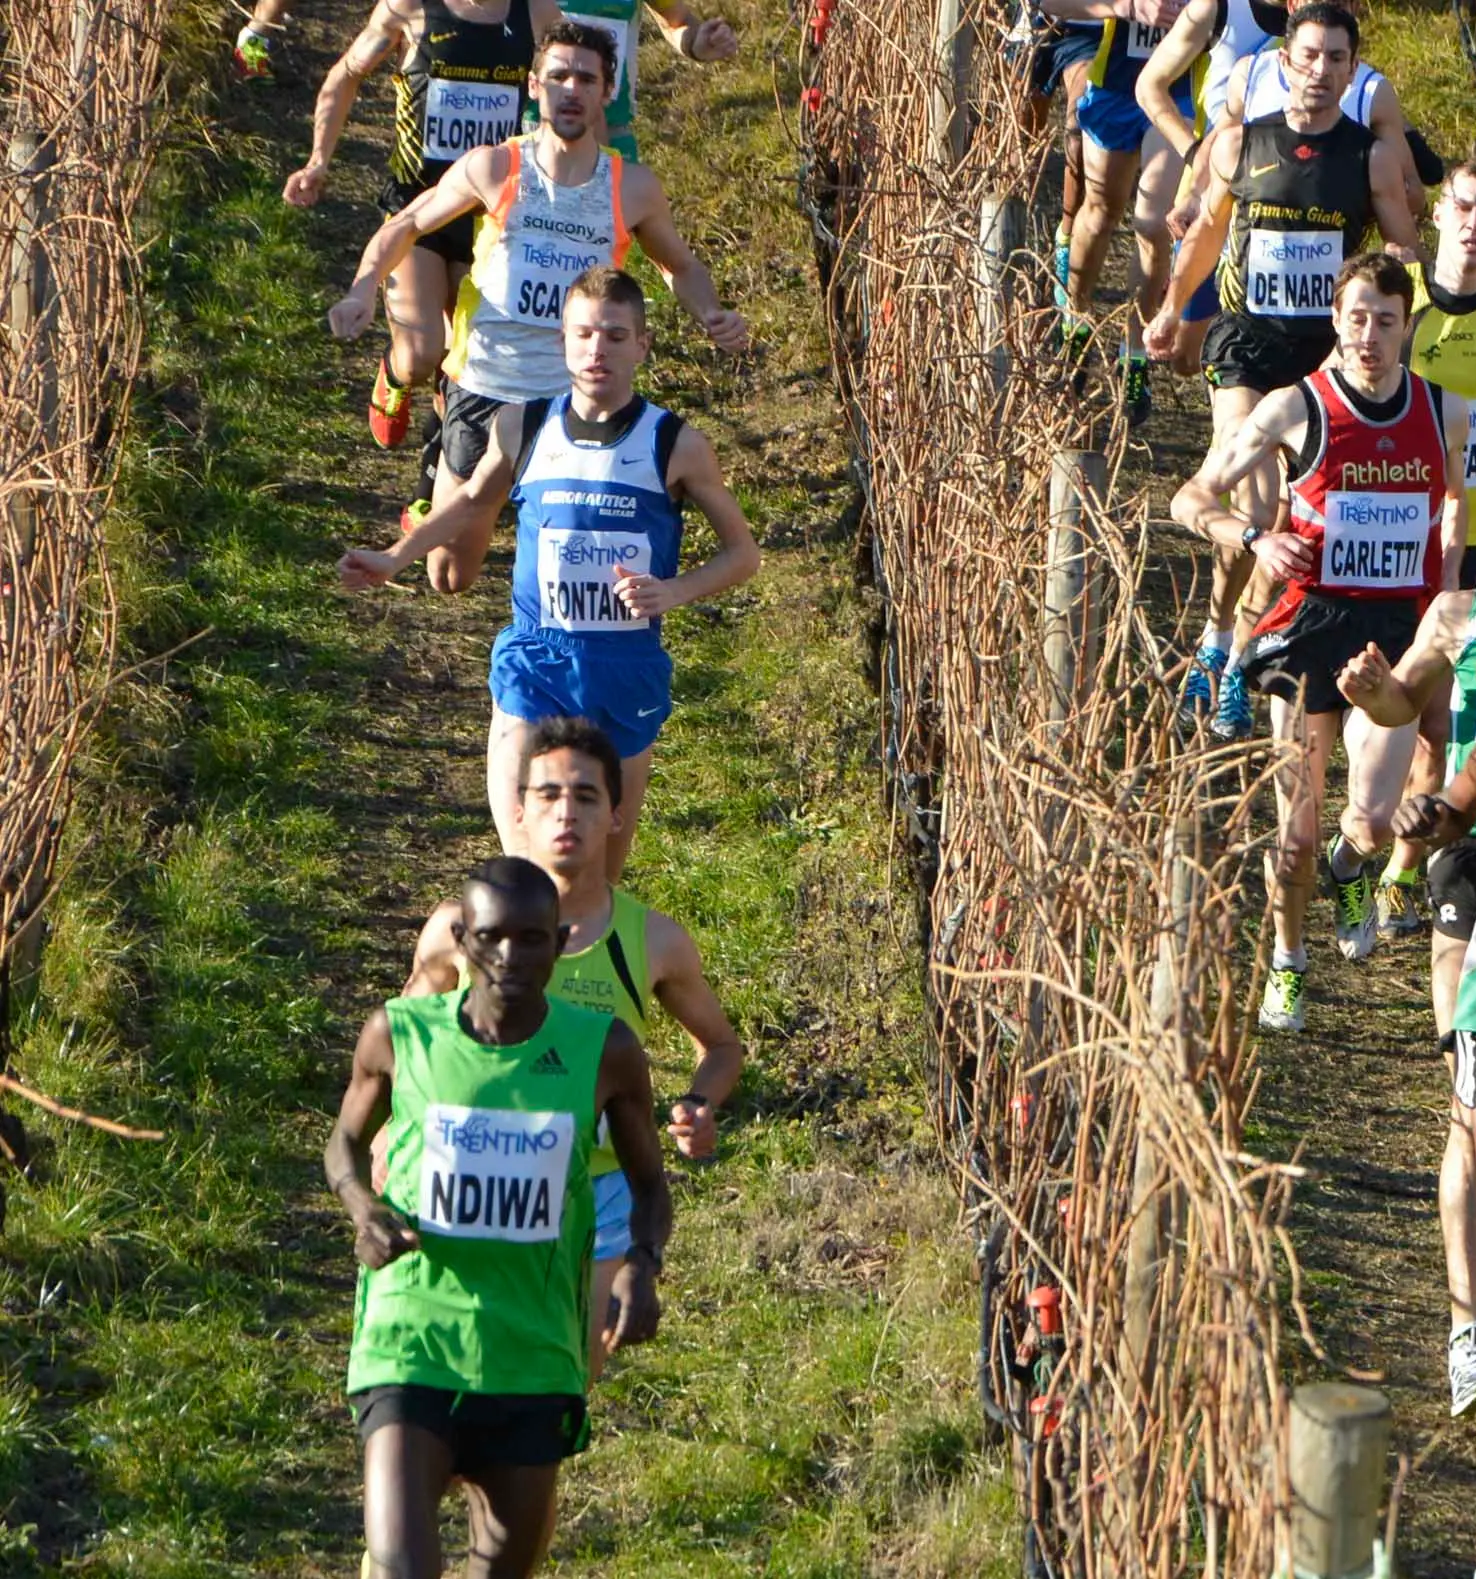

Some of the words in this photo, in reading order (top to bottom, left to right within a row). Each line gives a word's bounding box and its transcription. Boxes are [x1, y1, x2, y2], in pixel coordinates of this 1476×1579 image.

[438, 86, 510, 111] TRENTINO
[523, 215, 596, 240] saucony
[522, 243, 599, 271] TRENTINO
[1262, 239, 1332, 262] TRENTINO
[518, 280, 569, 320] SCA
[1254, 272, 1279, 307] DE
[1342, 457, 1431, 491] Athletic
[541, 490, 638, 509] AERONAUTICA
[1337, 500, 1419, 526] TRENTINO
[549, 539, 640, 567] TRENTINO
[1331, 539, 1420, 578] CARLETTI
[547, 580, 640, 622] FONTAN
[438, 1113, 558, 1156] TRENTINO
[431, 1170, 550, 1229] NDIWA
